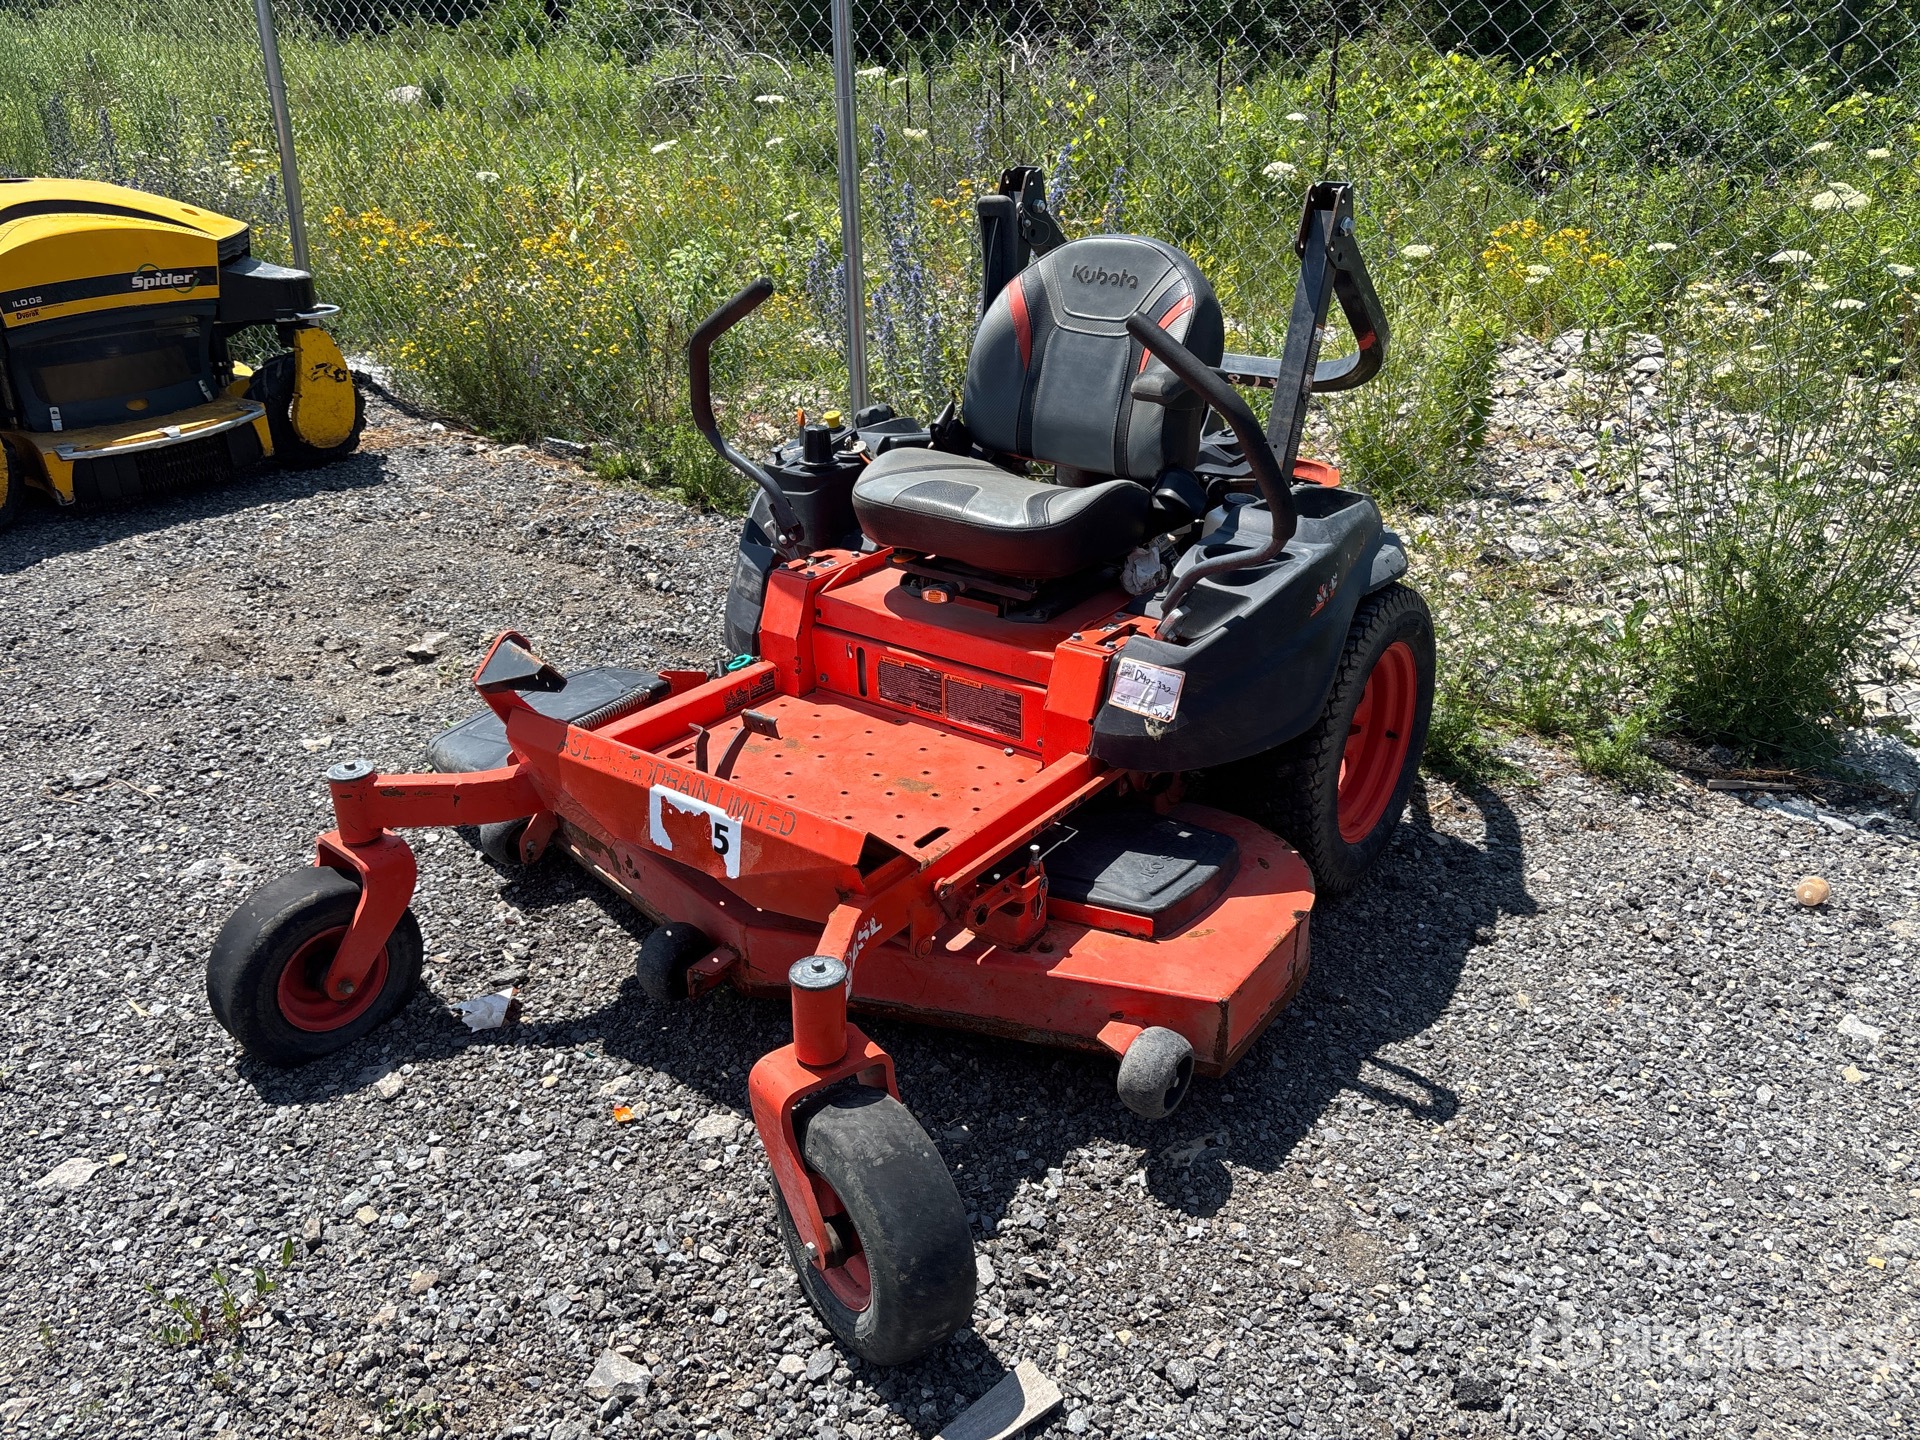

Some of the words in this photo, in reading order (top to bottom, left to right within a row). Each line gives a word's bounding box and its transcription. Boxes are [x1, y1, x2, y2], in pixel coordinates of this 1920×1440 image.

[131, 272, 194, 291] Spider
[1072, 264, 1139, 290] Kubota
[716, 786, 798, 838] LIMITED
[713, 823, 730, 856] 5
